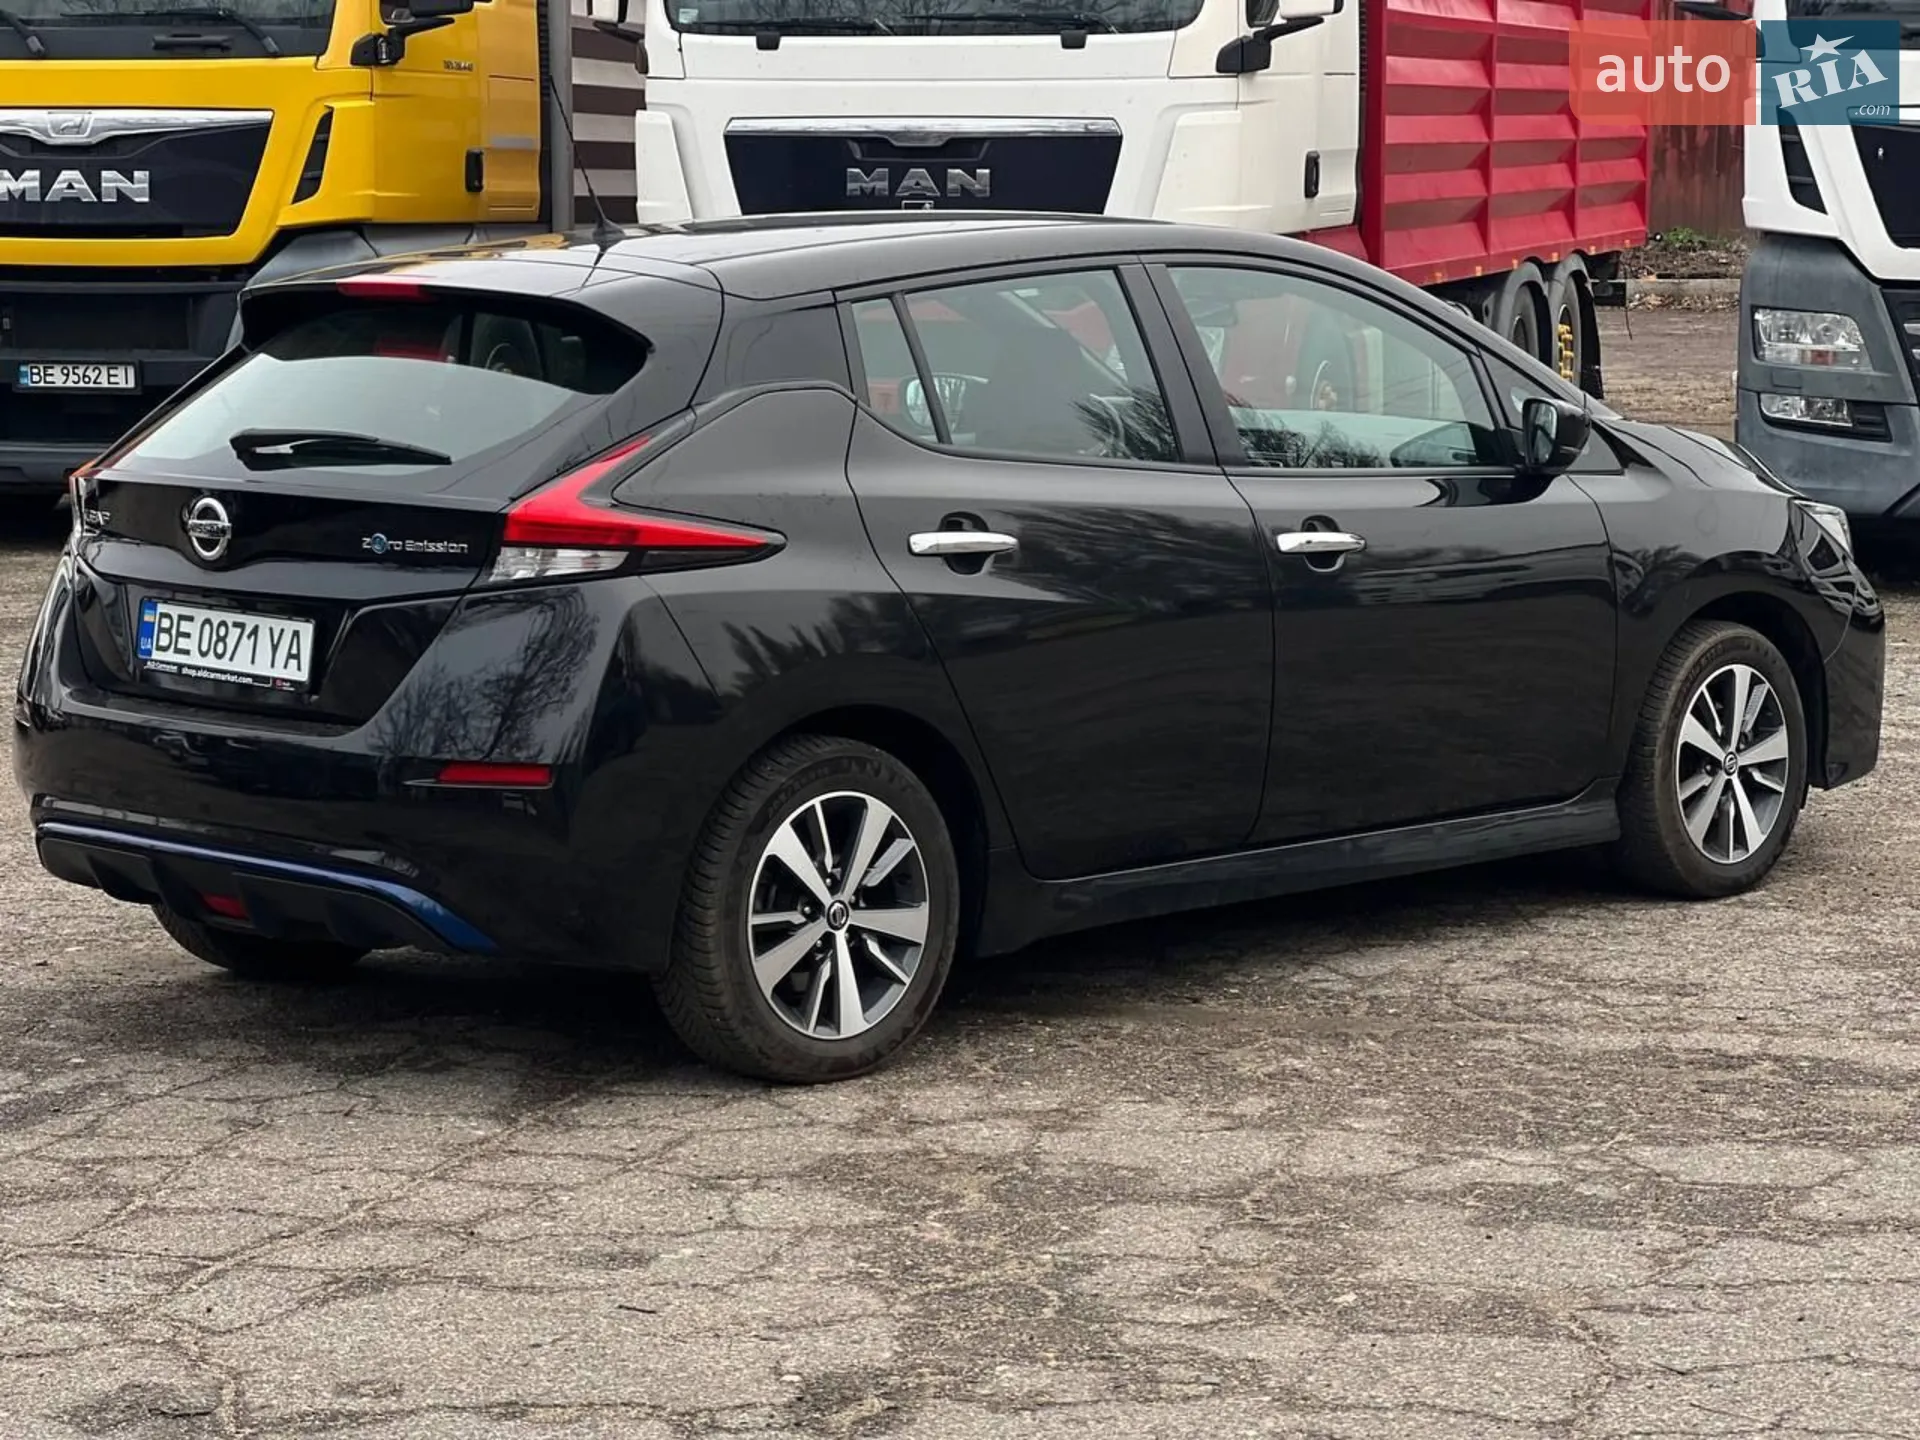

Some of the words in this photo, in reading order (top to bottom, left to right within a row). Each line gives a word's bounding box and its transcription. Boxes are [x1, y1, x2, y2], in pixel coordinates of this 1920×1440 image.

[0, 169, 150, 202] MAN
[846, 167, 991, 197] MAN
[29, 365, 56, 385] BE
[60, 366, 102, 385] 9562
[155, 611, 195, 656] BE
[198, 617, 260, 666] 0871
[268, 625, 303, 673] YA
